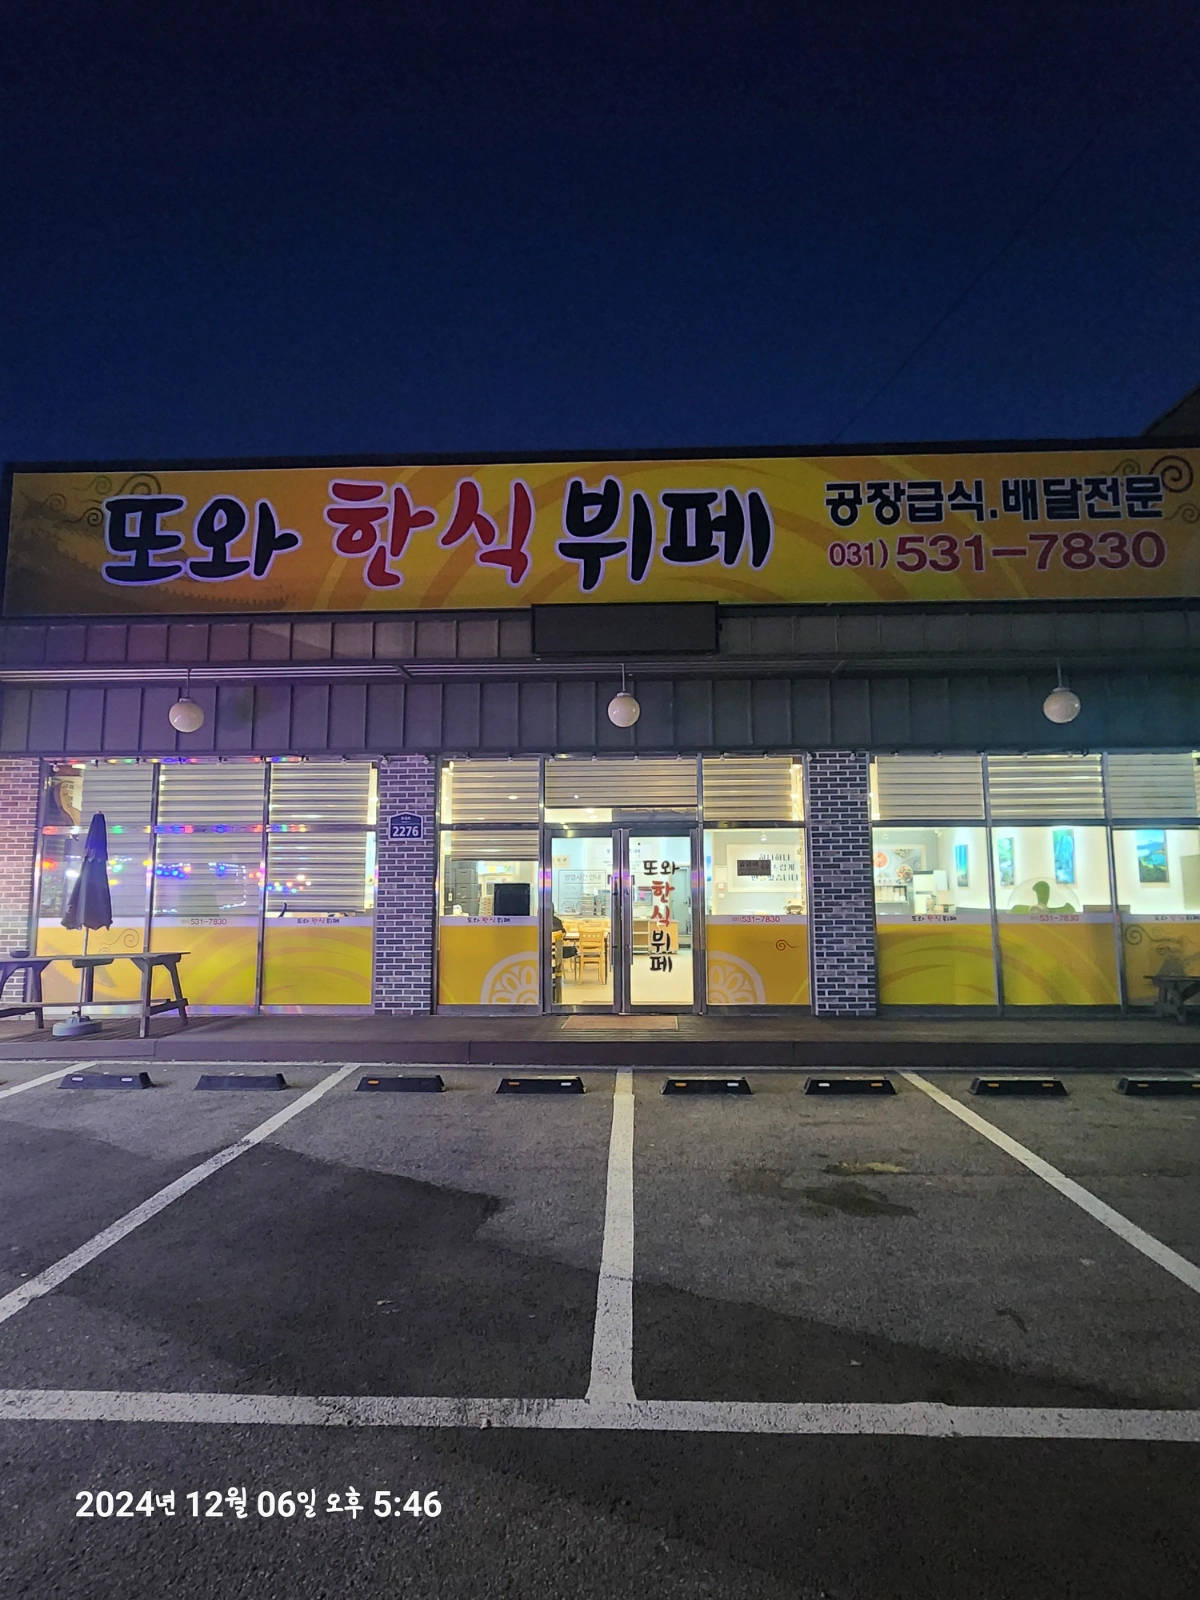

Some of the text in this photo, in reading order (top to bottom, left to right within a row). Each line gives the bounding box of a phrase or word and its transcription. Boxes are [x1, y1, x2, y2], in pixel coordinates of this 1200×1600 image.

[102, 476, 773, 591] 또와 한식 뷔페
[392, 826, 419, 837] 2276
[643, 860, 680, 875] 또와
